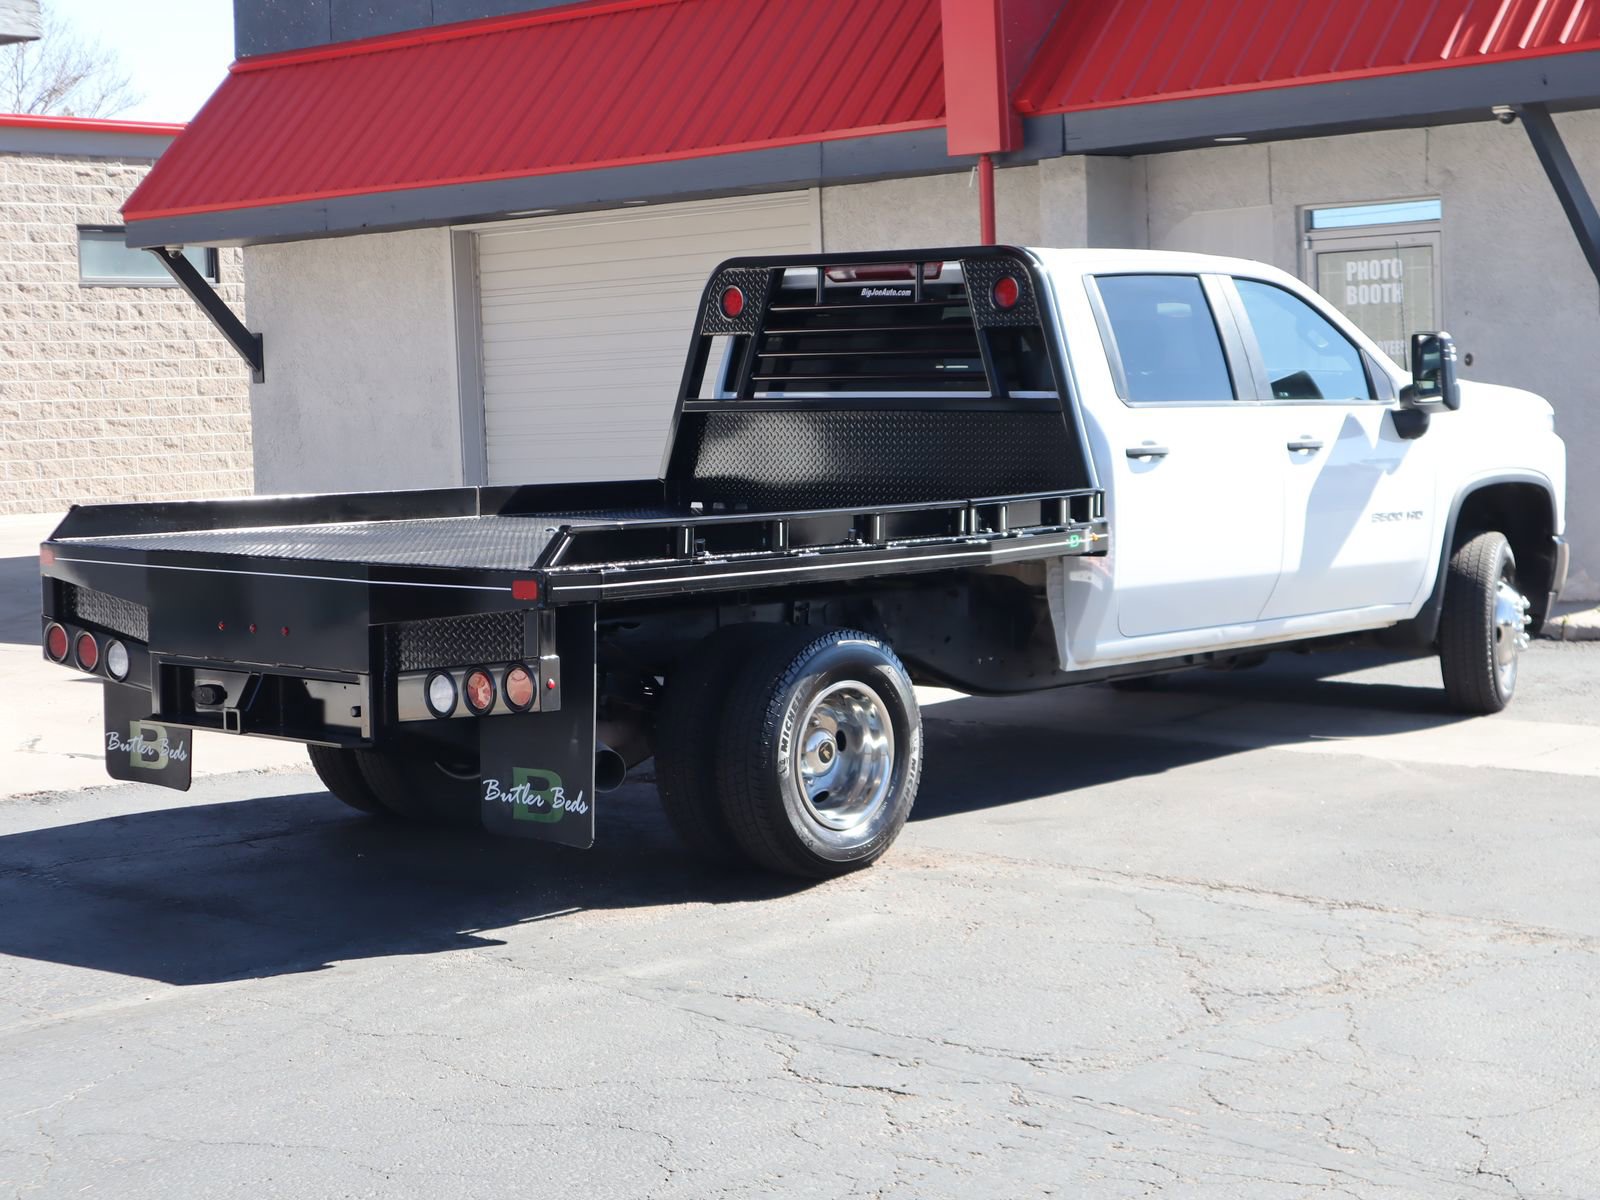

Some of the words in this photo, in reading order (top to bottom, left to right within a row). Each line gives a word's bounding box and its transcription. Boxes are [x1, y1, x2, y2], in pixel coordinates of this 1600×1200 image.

[1346, 258, 1403, 281] PHOTO
[861, 288, 912, 298] BigJoeAuto.com
[1346, 282, 1403, 305] BOOTH
[105, 731, 154, 757] Butler
[158, 737, 188, 761] Beds
[482, 779, 545, 807] Butler
[550, 786, 589, 815] Beds
